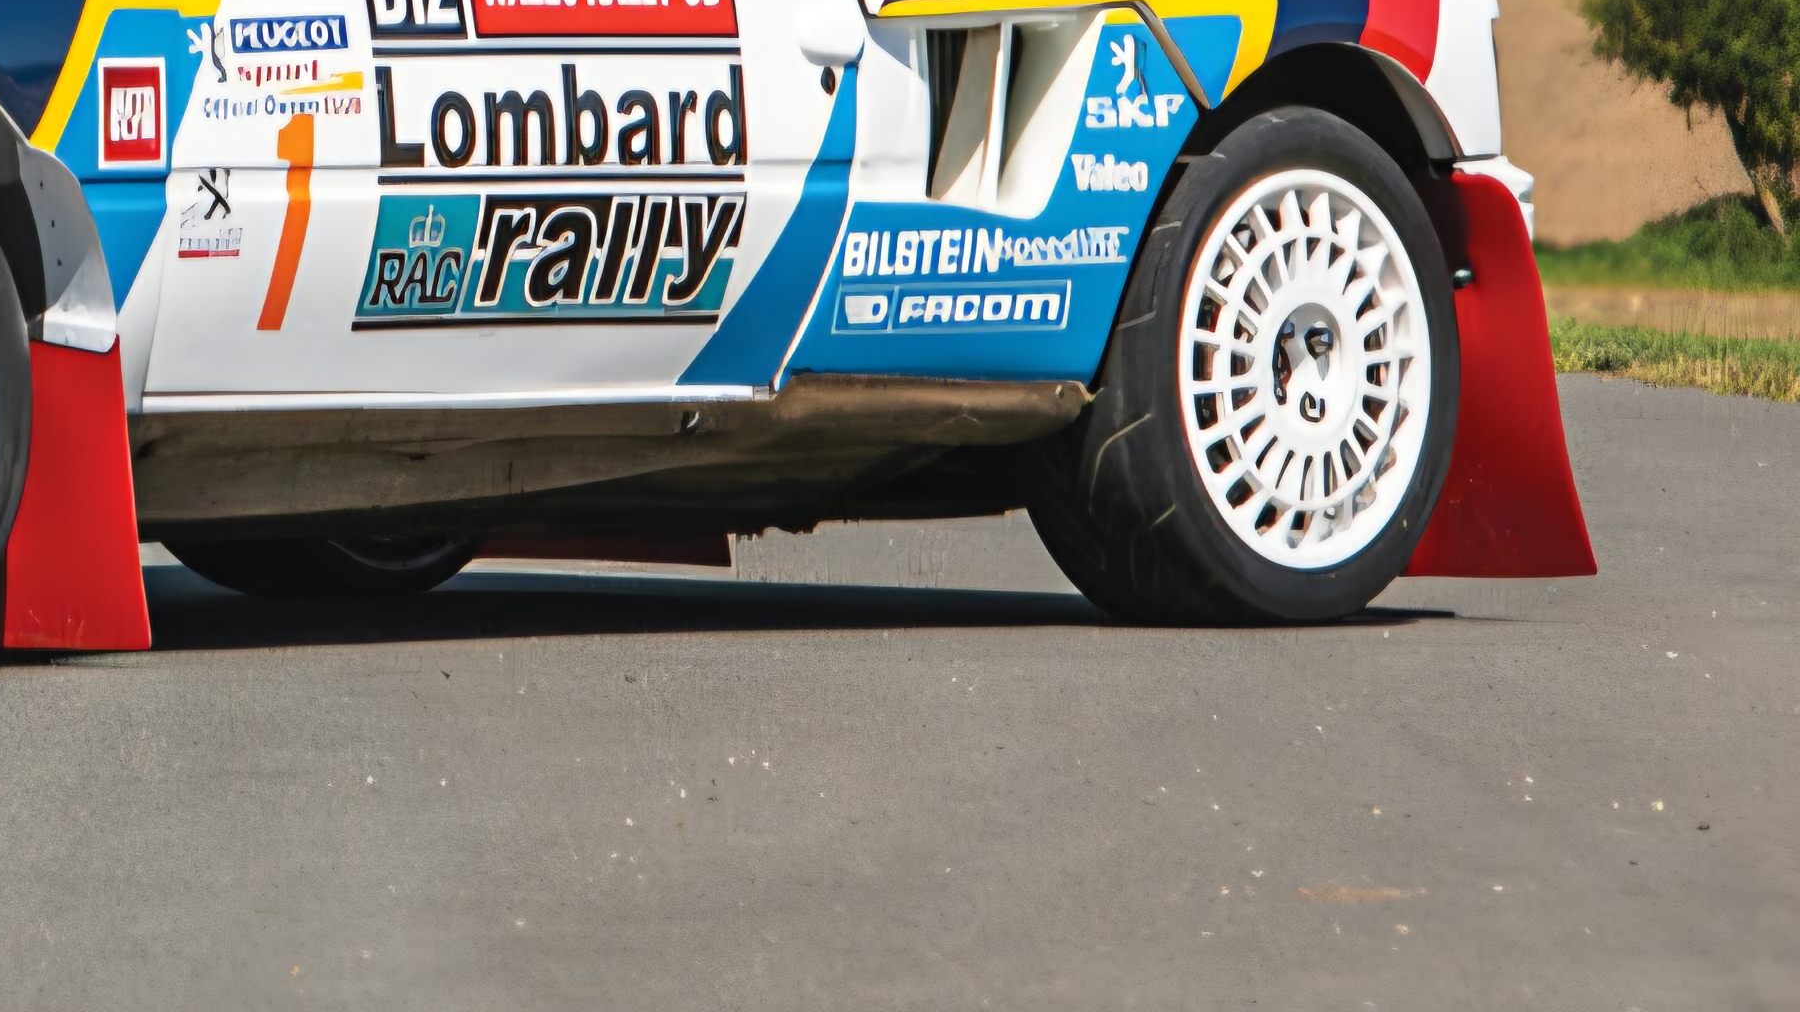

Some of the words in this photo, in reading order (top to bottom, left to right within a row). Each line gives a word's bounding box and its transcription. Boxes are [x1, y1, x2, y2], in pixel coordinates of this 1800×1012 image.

[374, 62, 746, 168] Lombard
[368, 248, 462, 309] RAC
[470, 192, 746, 308] rally
[842, 227, 1004, 277] BILSTEIN
